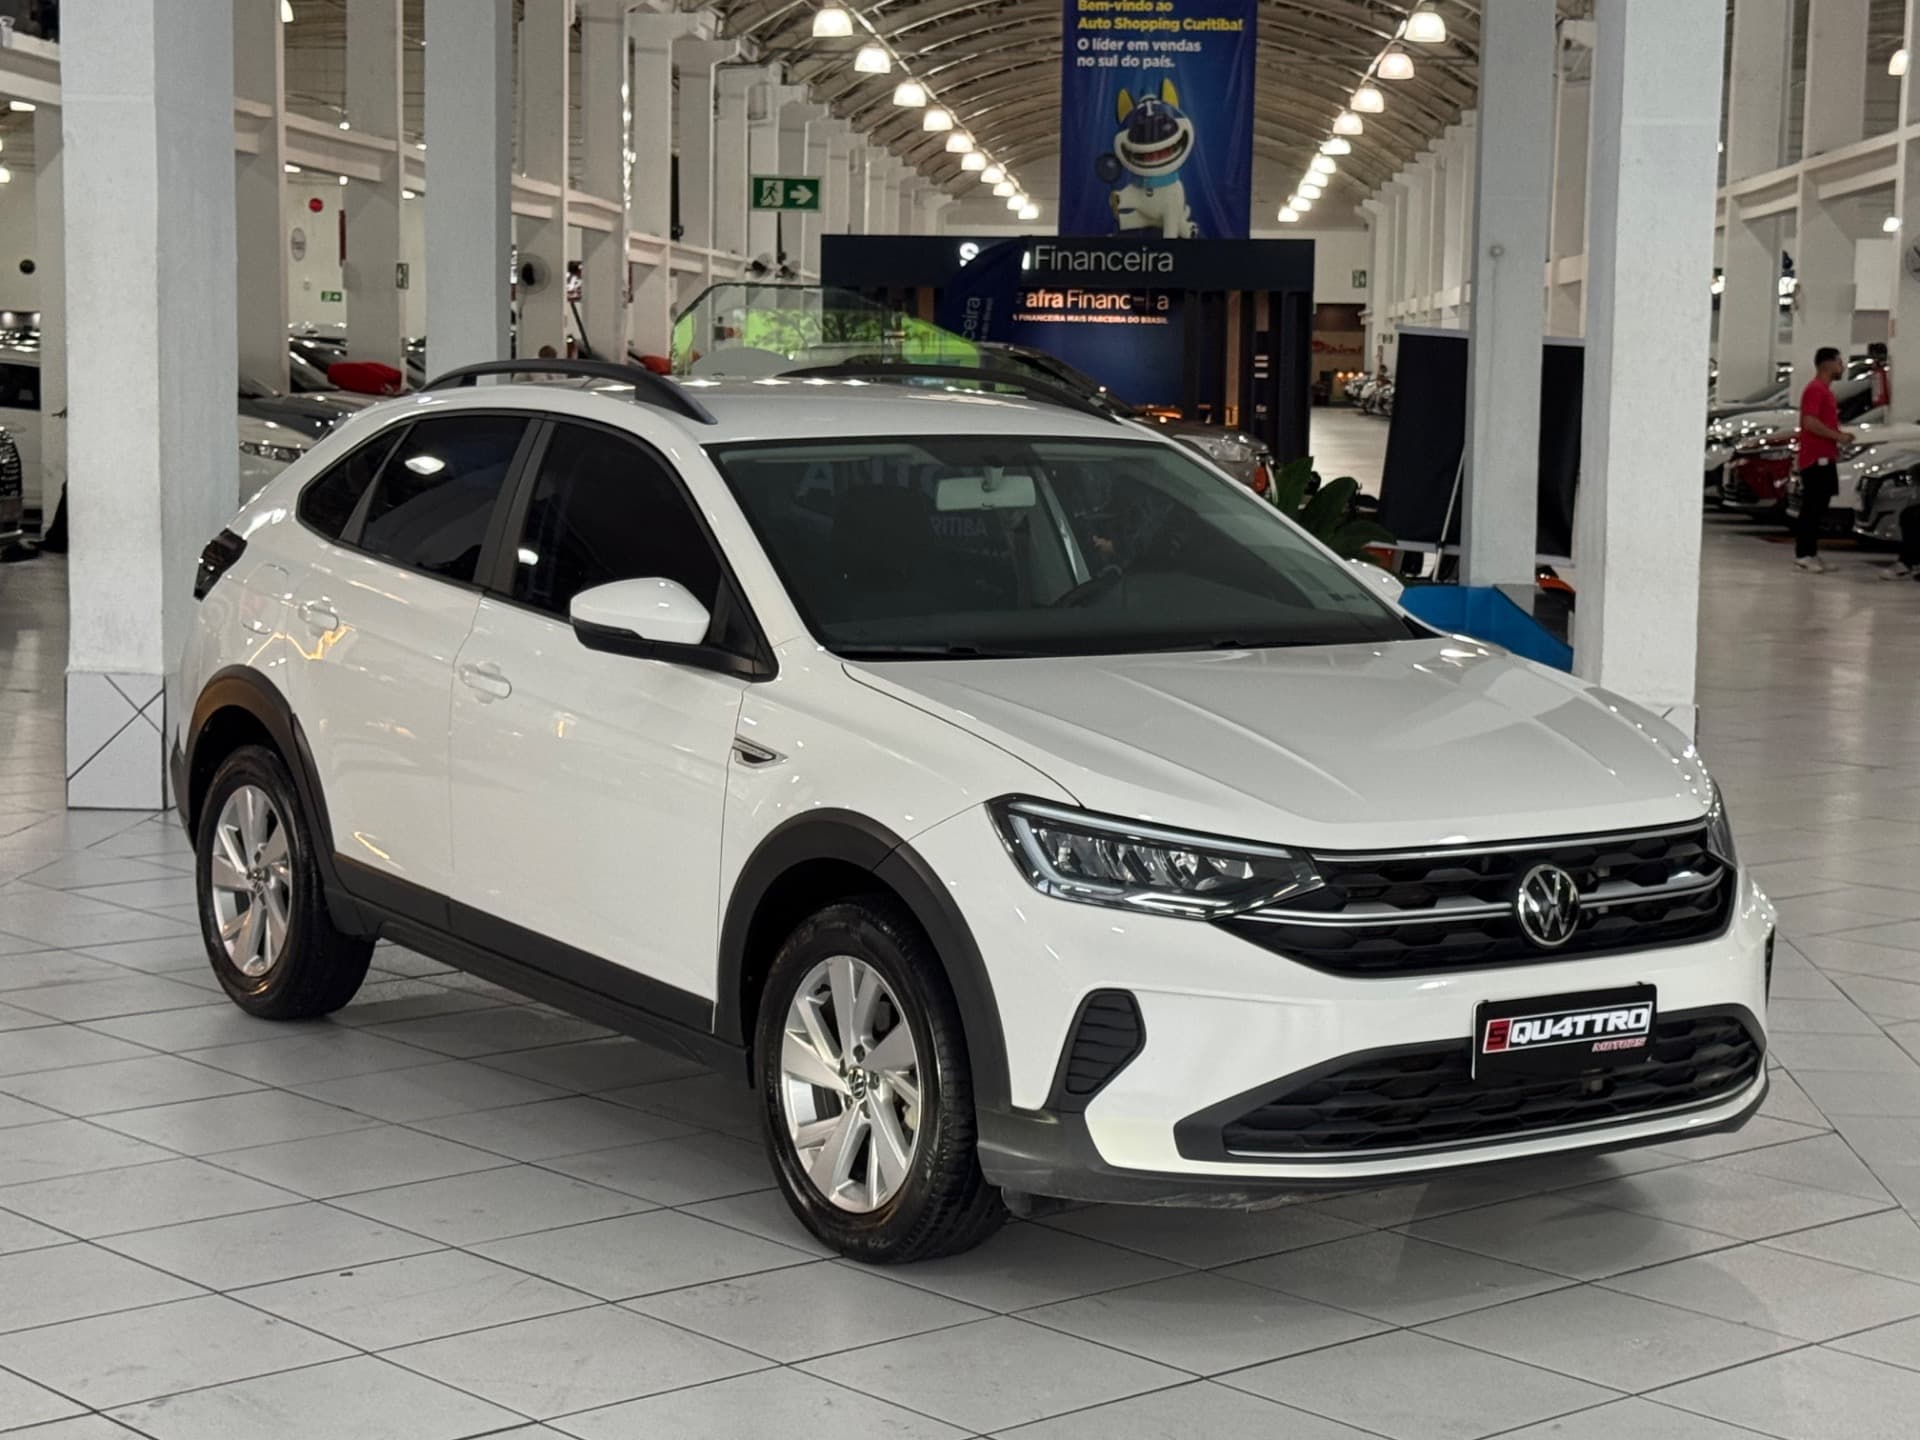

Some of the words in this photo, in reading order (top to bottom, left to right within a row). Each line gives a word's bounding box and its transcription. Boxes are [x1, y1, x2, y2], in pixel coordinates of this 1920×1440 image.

[1078, 0, 1153, 12] Bem-vindo
[1156, 2, 1173, 12] ao
[1078, 18, 1112, 30] Auto
[1114, 17, 1180, 32] Shopping
[1183, 18, 1243, 31] Curitiba!
[1077, 38, 1089, 51] O
[1092, 38, 1124, 51] líder
[1127, 41, 1149, 51] em
[1152, 39, 1202, 52] vendas
[1077, 56, 1094, 67] no
[1098, 55, 1118, 67] sul
[1121, 55, 1140, 67] do
[1143, 55, 1175, 69] país.
[1035, 245, 1173, 273] Financeira
[1017, 288, 1064, 309] afra
